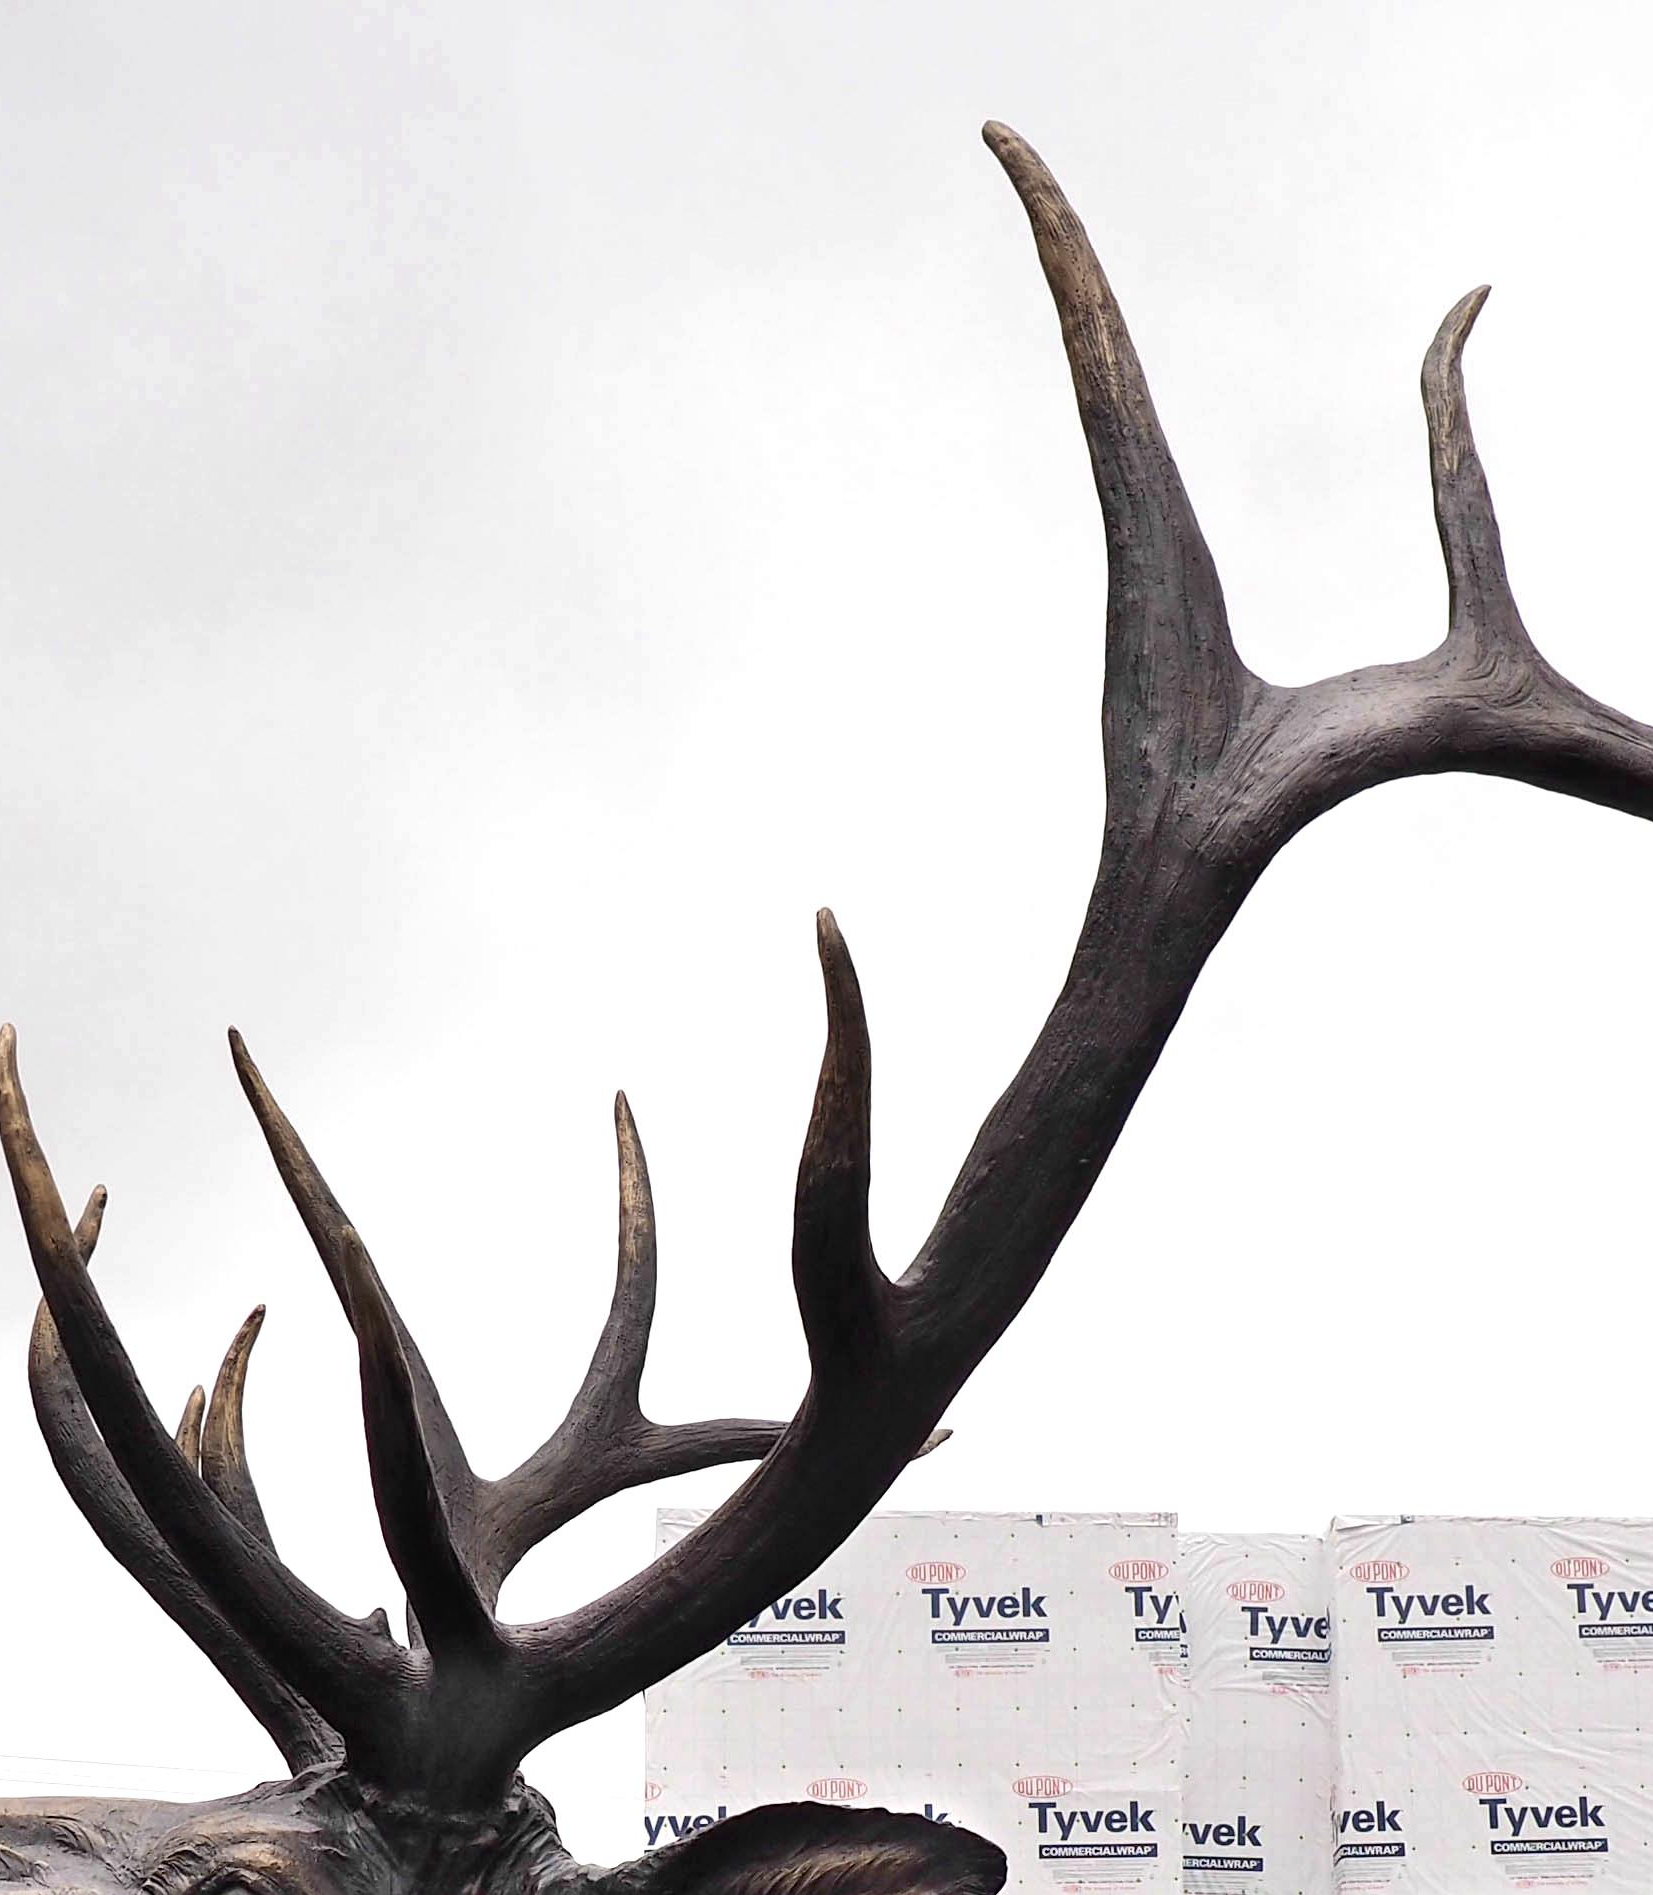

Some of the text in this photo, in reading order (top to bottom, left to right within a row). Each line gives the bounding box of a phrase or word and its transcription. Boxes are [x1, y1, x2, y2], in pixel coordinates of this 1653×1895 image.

[922, 1588, 1047, 1626] Tyvek
[1366, 1585, 1491, 1624] Tyvek
[730, 1632, 840, 1643] COMMERCIALWRAP
[934, 1631, 1043, 1642] COMMERCIALWRAP
[1242, 1606, 1331, 1644] Tyve
[1381, 1628, 1489, 1639] COMMERCIALWRAP
[1029, 1801, 1155, 1840] Tyvek
[1184, 1816, 1262, 1846] vek
[1479, 1797, 1605, 1836] Tyvek
[1042, 1846, 1151, 1857] COMMERCIALWRAP
[1494, 1841, 1601, 1852] COMMERCIALWRAP
